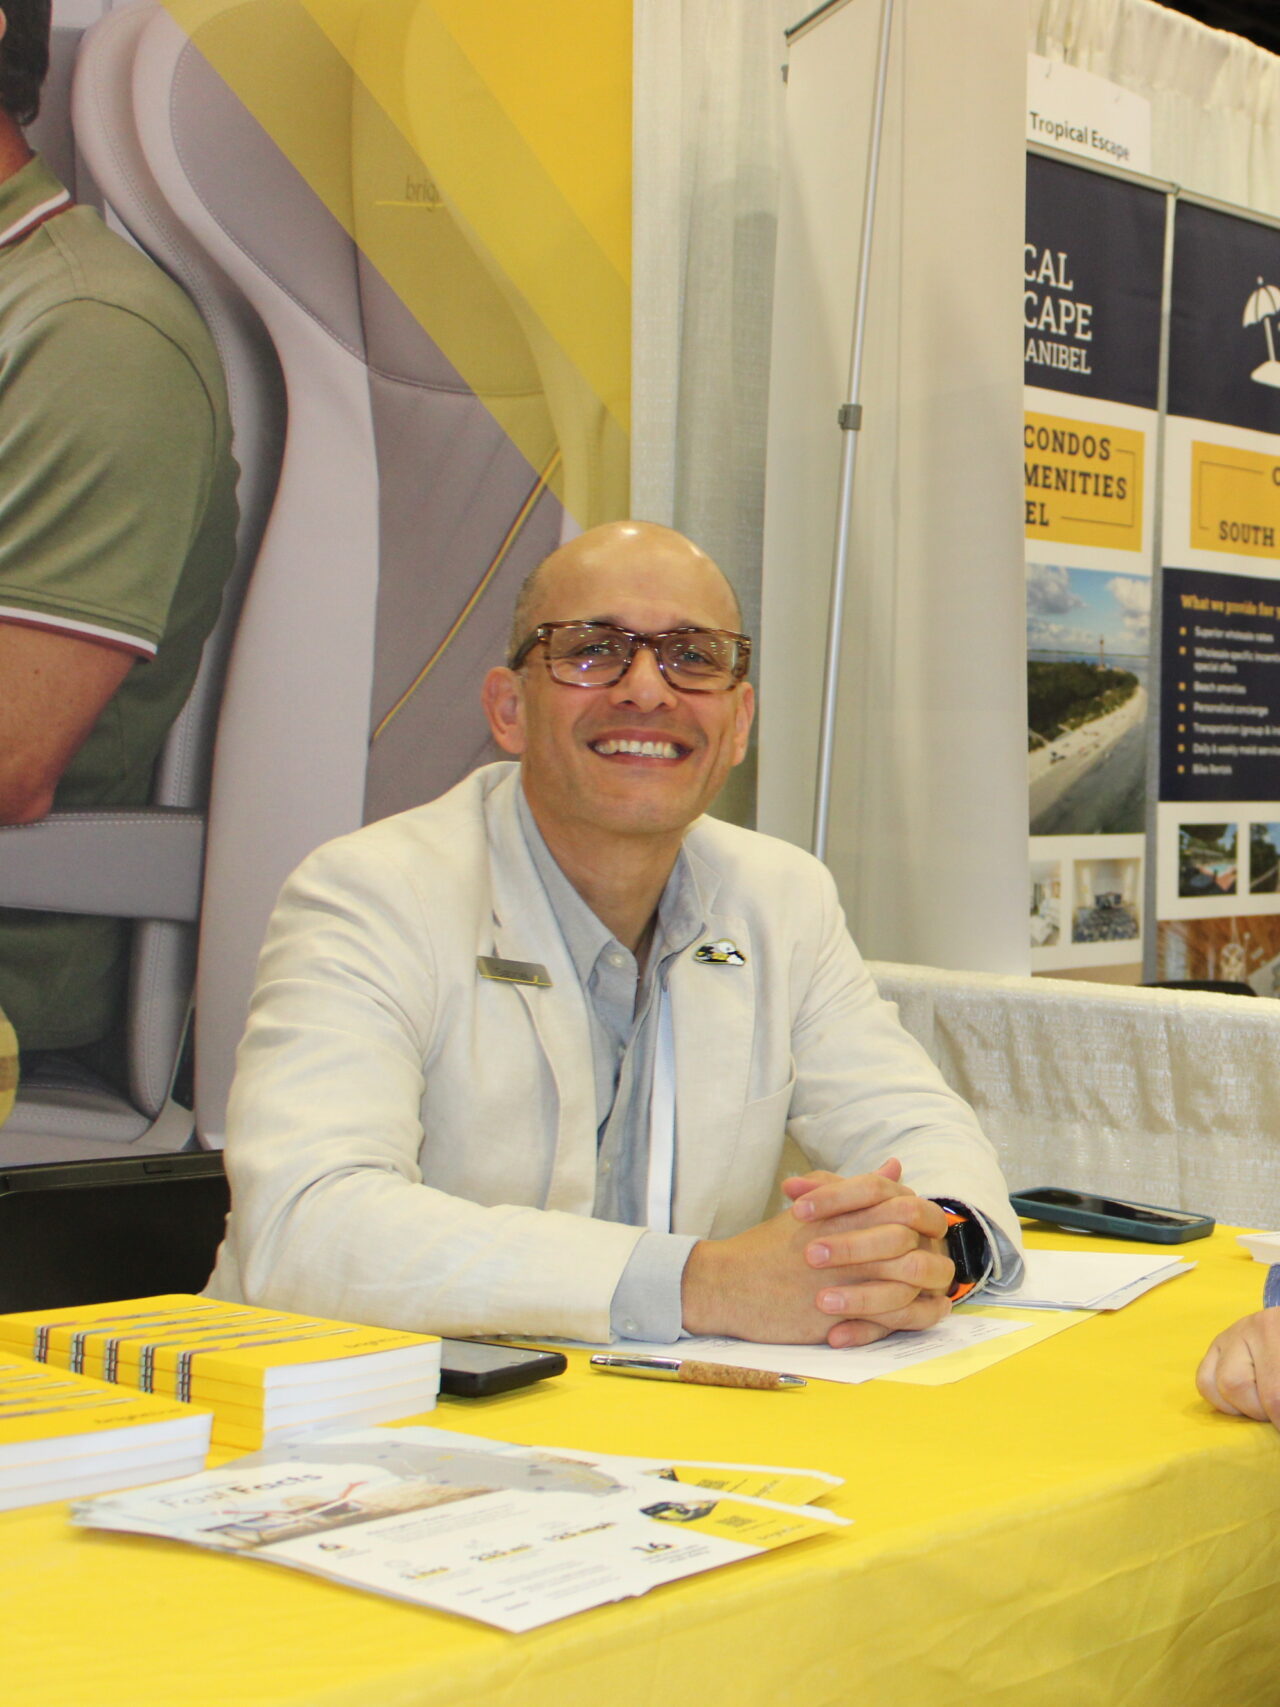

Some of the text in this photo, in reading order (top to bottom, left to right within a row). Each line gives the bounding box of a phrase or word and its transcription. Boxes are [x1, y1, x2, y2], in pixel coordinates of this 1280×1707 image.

[1030, 111, 1129, 161] Tropical Escape
[1024, 423, 1111, 461] CONDOS
[1219, 519, 1275, 548] SOUTH
